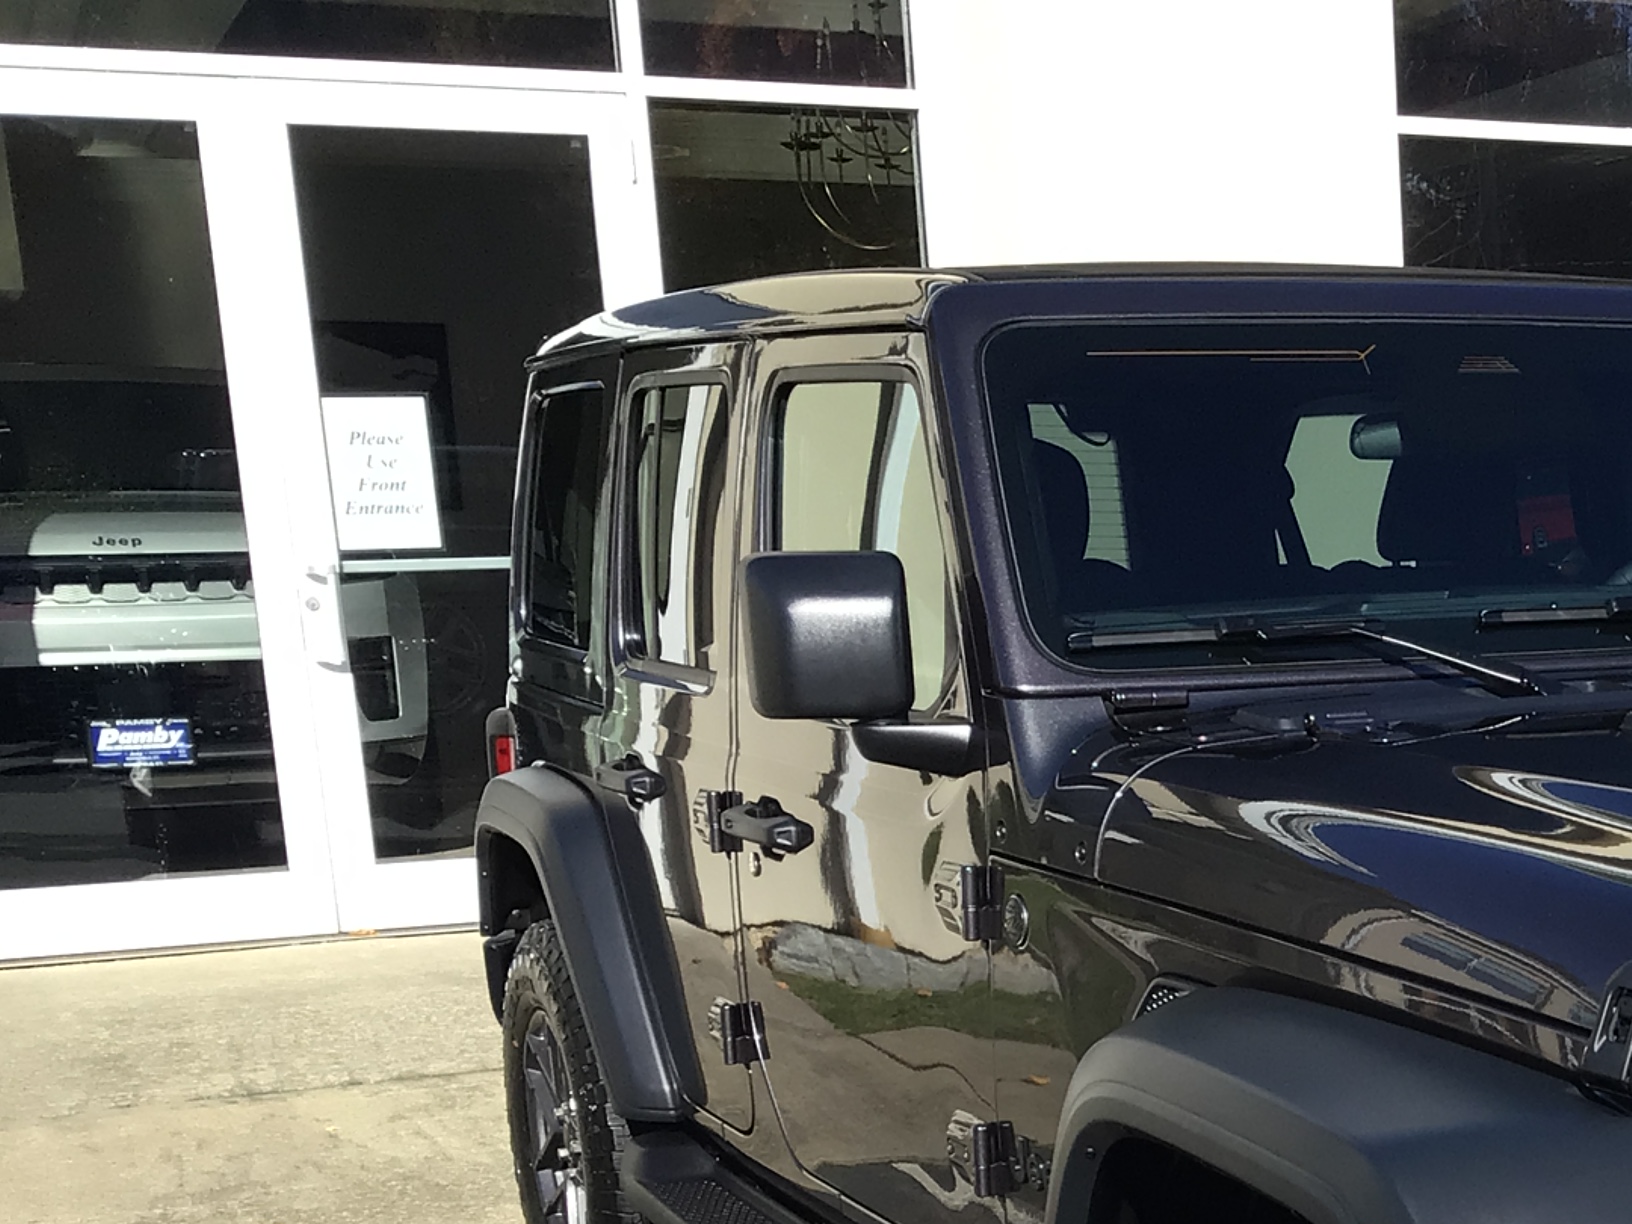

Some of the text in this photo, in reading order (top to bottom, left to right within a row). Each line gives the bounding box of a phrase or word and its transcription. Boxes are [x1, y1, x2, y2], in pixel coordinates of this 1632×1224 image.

[348, 430, 404, 446] Please
[358, 477, 407, 492] Front
[345, 500, 424, 515] Entrance
[91, 535, 143, 548] Jeep
[96, 725, 185, 752] Pamby
